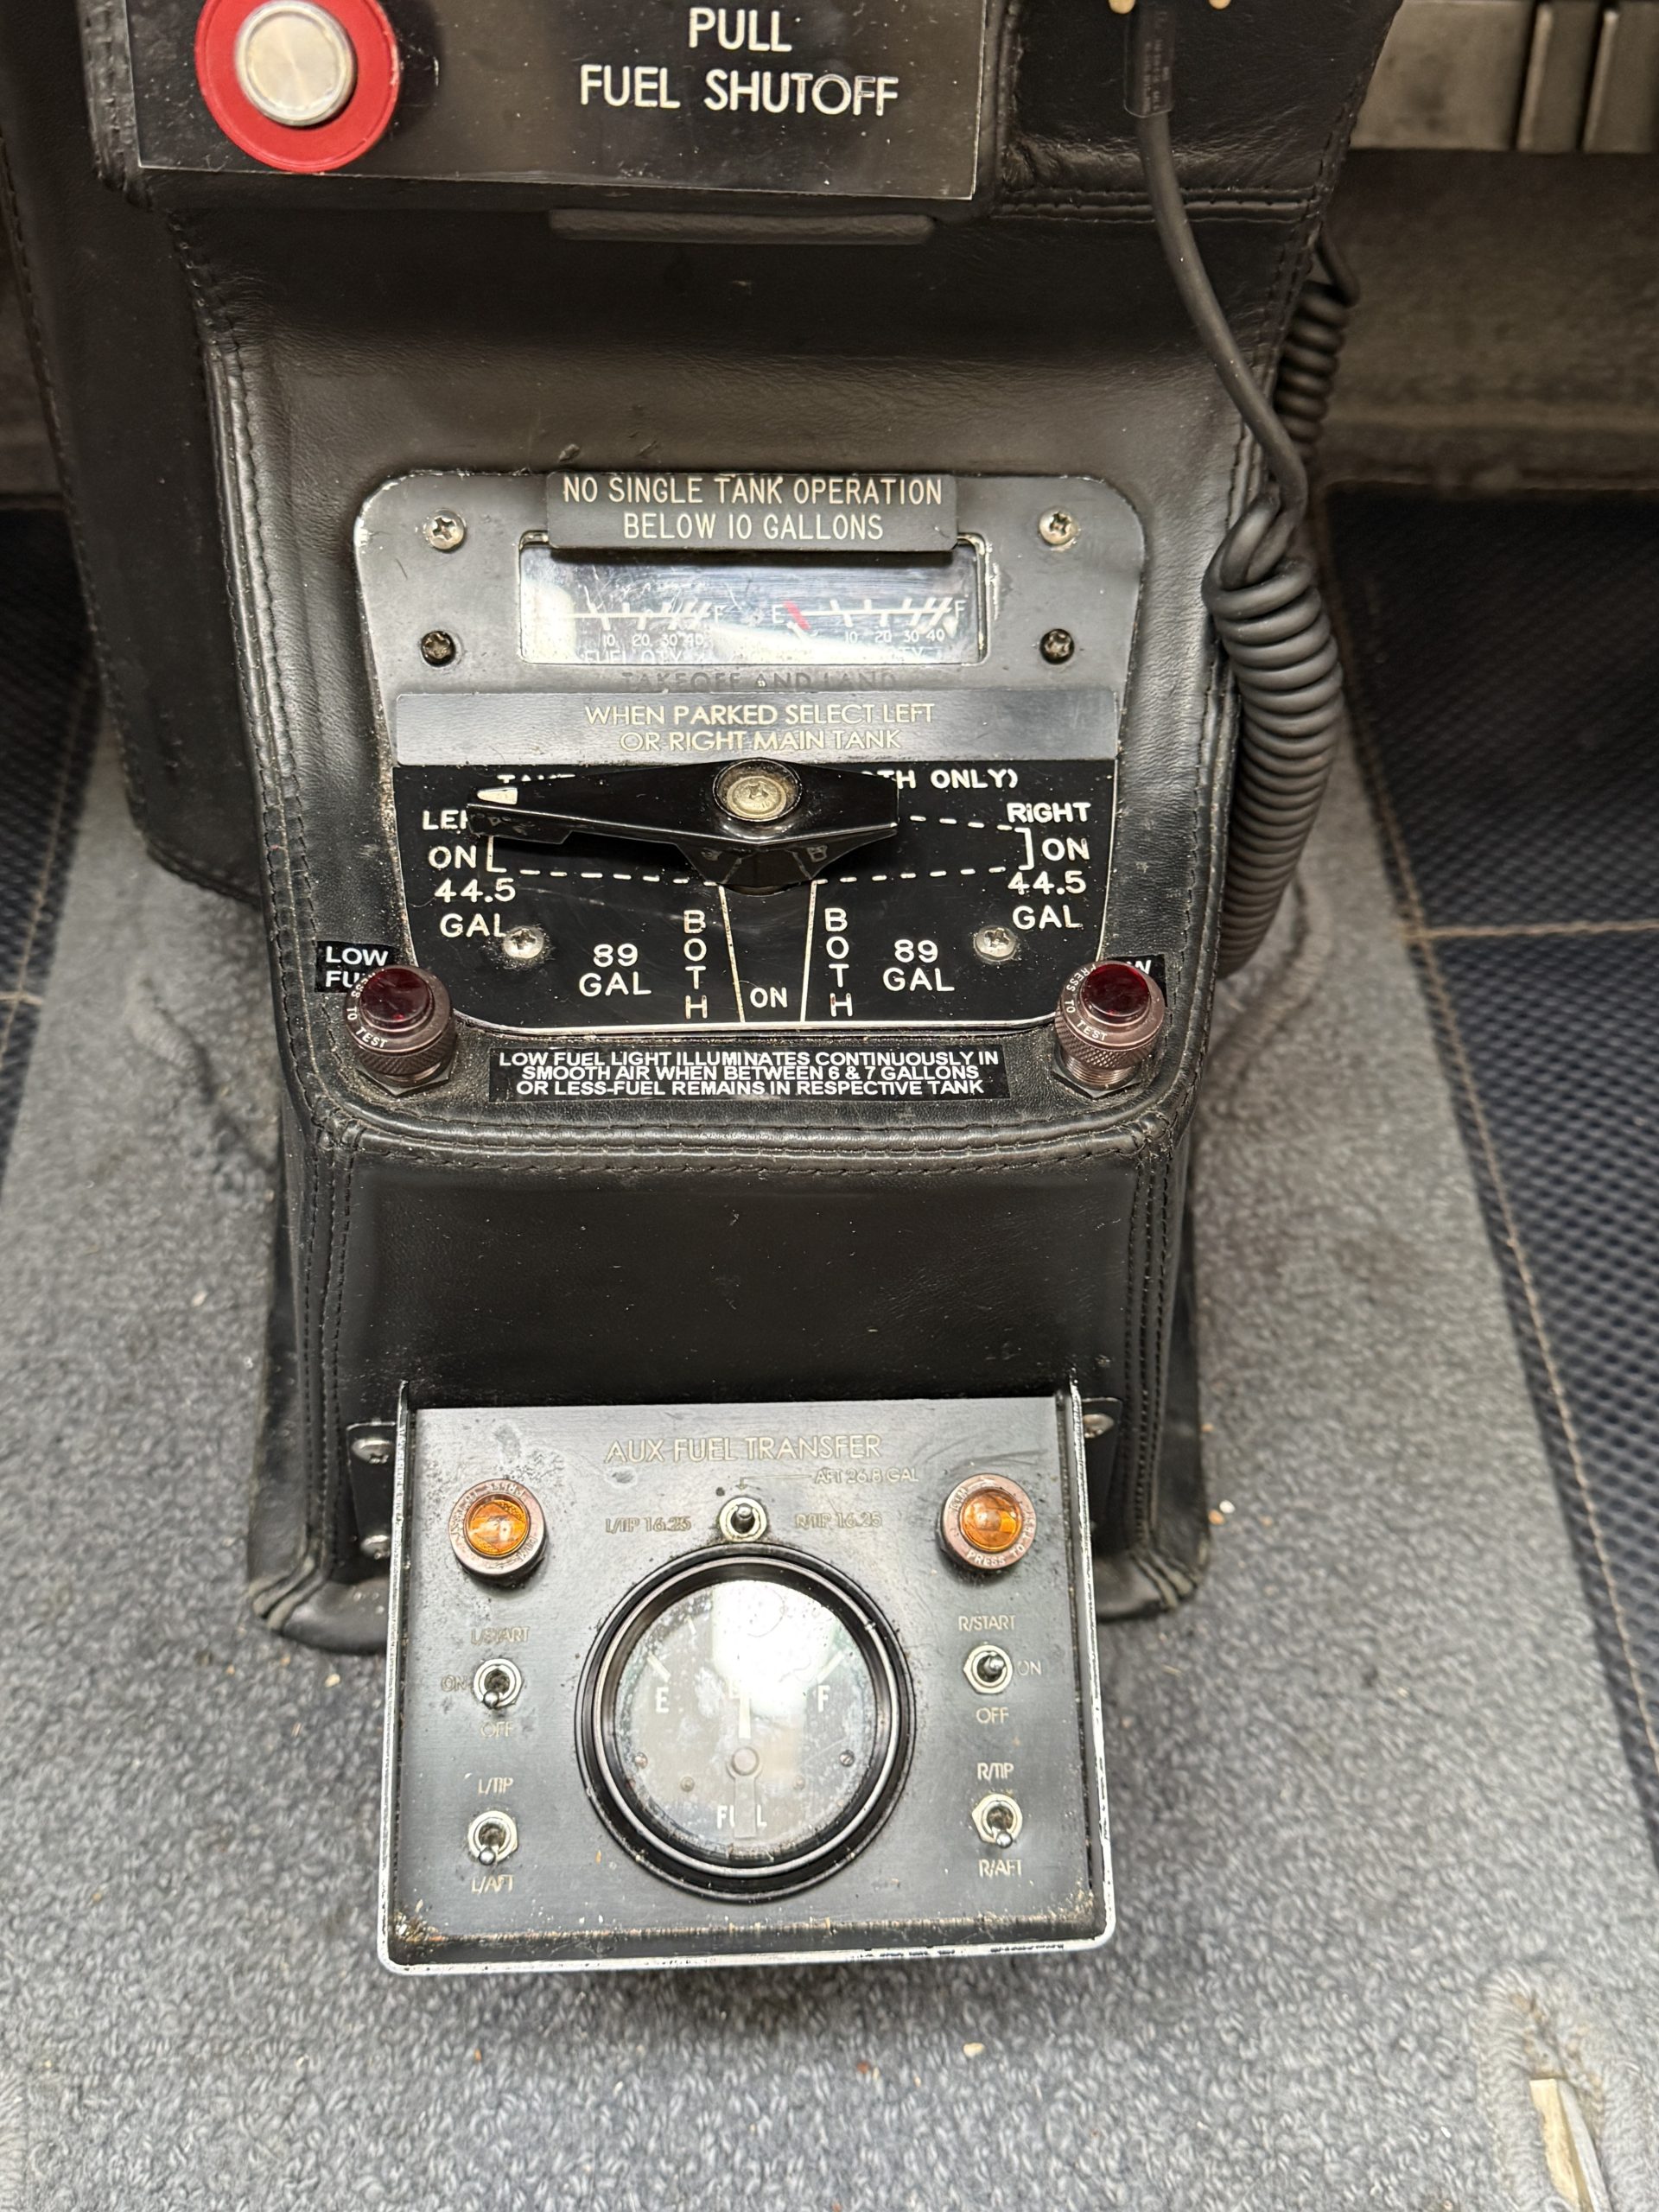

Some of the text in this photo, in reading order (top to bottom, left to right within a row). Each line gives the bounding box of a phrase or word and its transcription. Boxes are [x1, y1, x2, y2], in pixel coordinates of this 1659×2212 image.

[689, 7, 792, 52] PULL
[580, 64, 899, 117] FUEL SHUTOFF
[563, 477, 942, 505] NO SINGLE TANK OPERATION
[624, 512, 715, 539] BELOW
[763, 513, 883, 540] GALLONS
[955, 600, 968, 620] F
[632, 634, 650, 648] 20
[874, 630, 892, 643] 20
[904, 630, 919, 643] 30
[926, 629, 945, 642] 40
[585, 702, 935, 726] WHEN PARKED SELECT LEFT
[620, 729, 901, 752] OR RIGHT MAIN TANK
[930, 768, 1018, 789] ONLY)
[1007, 802, 1091, 823] RIGHT
[428, 845, 477, 869] ON
[1042, 836, 1090, 861] ON
[434, 877, 517, 903] 44.5
[1007, 870, 1086, 895] 44.5
[439, 912, 506, 938] GAL
[1012, 905, 1084, 930] GAL
[326, 946, 389, 967] LOW
[593, 943, 639, 968] 89
[893, 938, 938, 963] 89
[578, 971, 652, 996] GAL
[883, 967, 955, 993] GAL
[749, 987, 787, 1008] ON
[346, 1007, 358, 1021] TO
[355, 1027, 388, 1048] TEST
[1064, 1000, 1076, 1014] TO
[1076, 1020, 1108, 1041] TEST
[499, 1051, 999, 1066] LOW FUEL LIGHT ILLUMINATES CONTINUOUSLY IN
[522, 1065, 979, 1081] SMOOTH AIR WHEN BETWEEN 6 & 7 GALLONS
[516, 1079, 984, 1096] OR LESS-FUEL REMAINS IN RESPECTIVE TANK
[606, 1433, 881, 1464] AUX FUEL TRANSFER
[814, 1468, 843, 1484] AFT
[887, 1467, 919, 1483] GAL
[967, 1550, 1007, 1567] PRESS
[1009, 1541, 1026, 1558] TO
[958, 1615, 1015, 1631] R/START
[1018, 1661, 1041, 1675] ON
[655, 1687, 669, 1713] E
[817, 1685, 830, 1712] F
[976, 1707, 1009, 1724] OFF
[480, 1721, 513, 1738] OFF
[978, 1859, 1022, 1877] R/AFT
